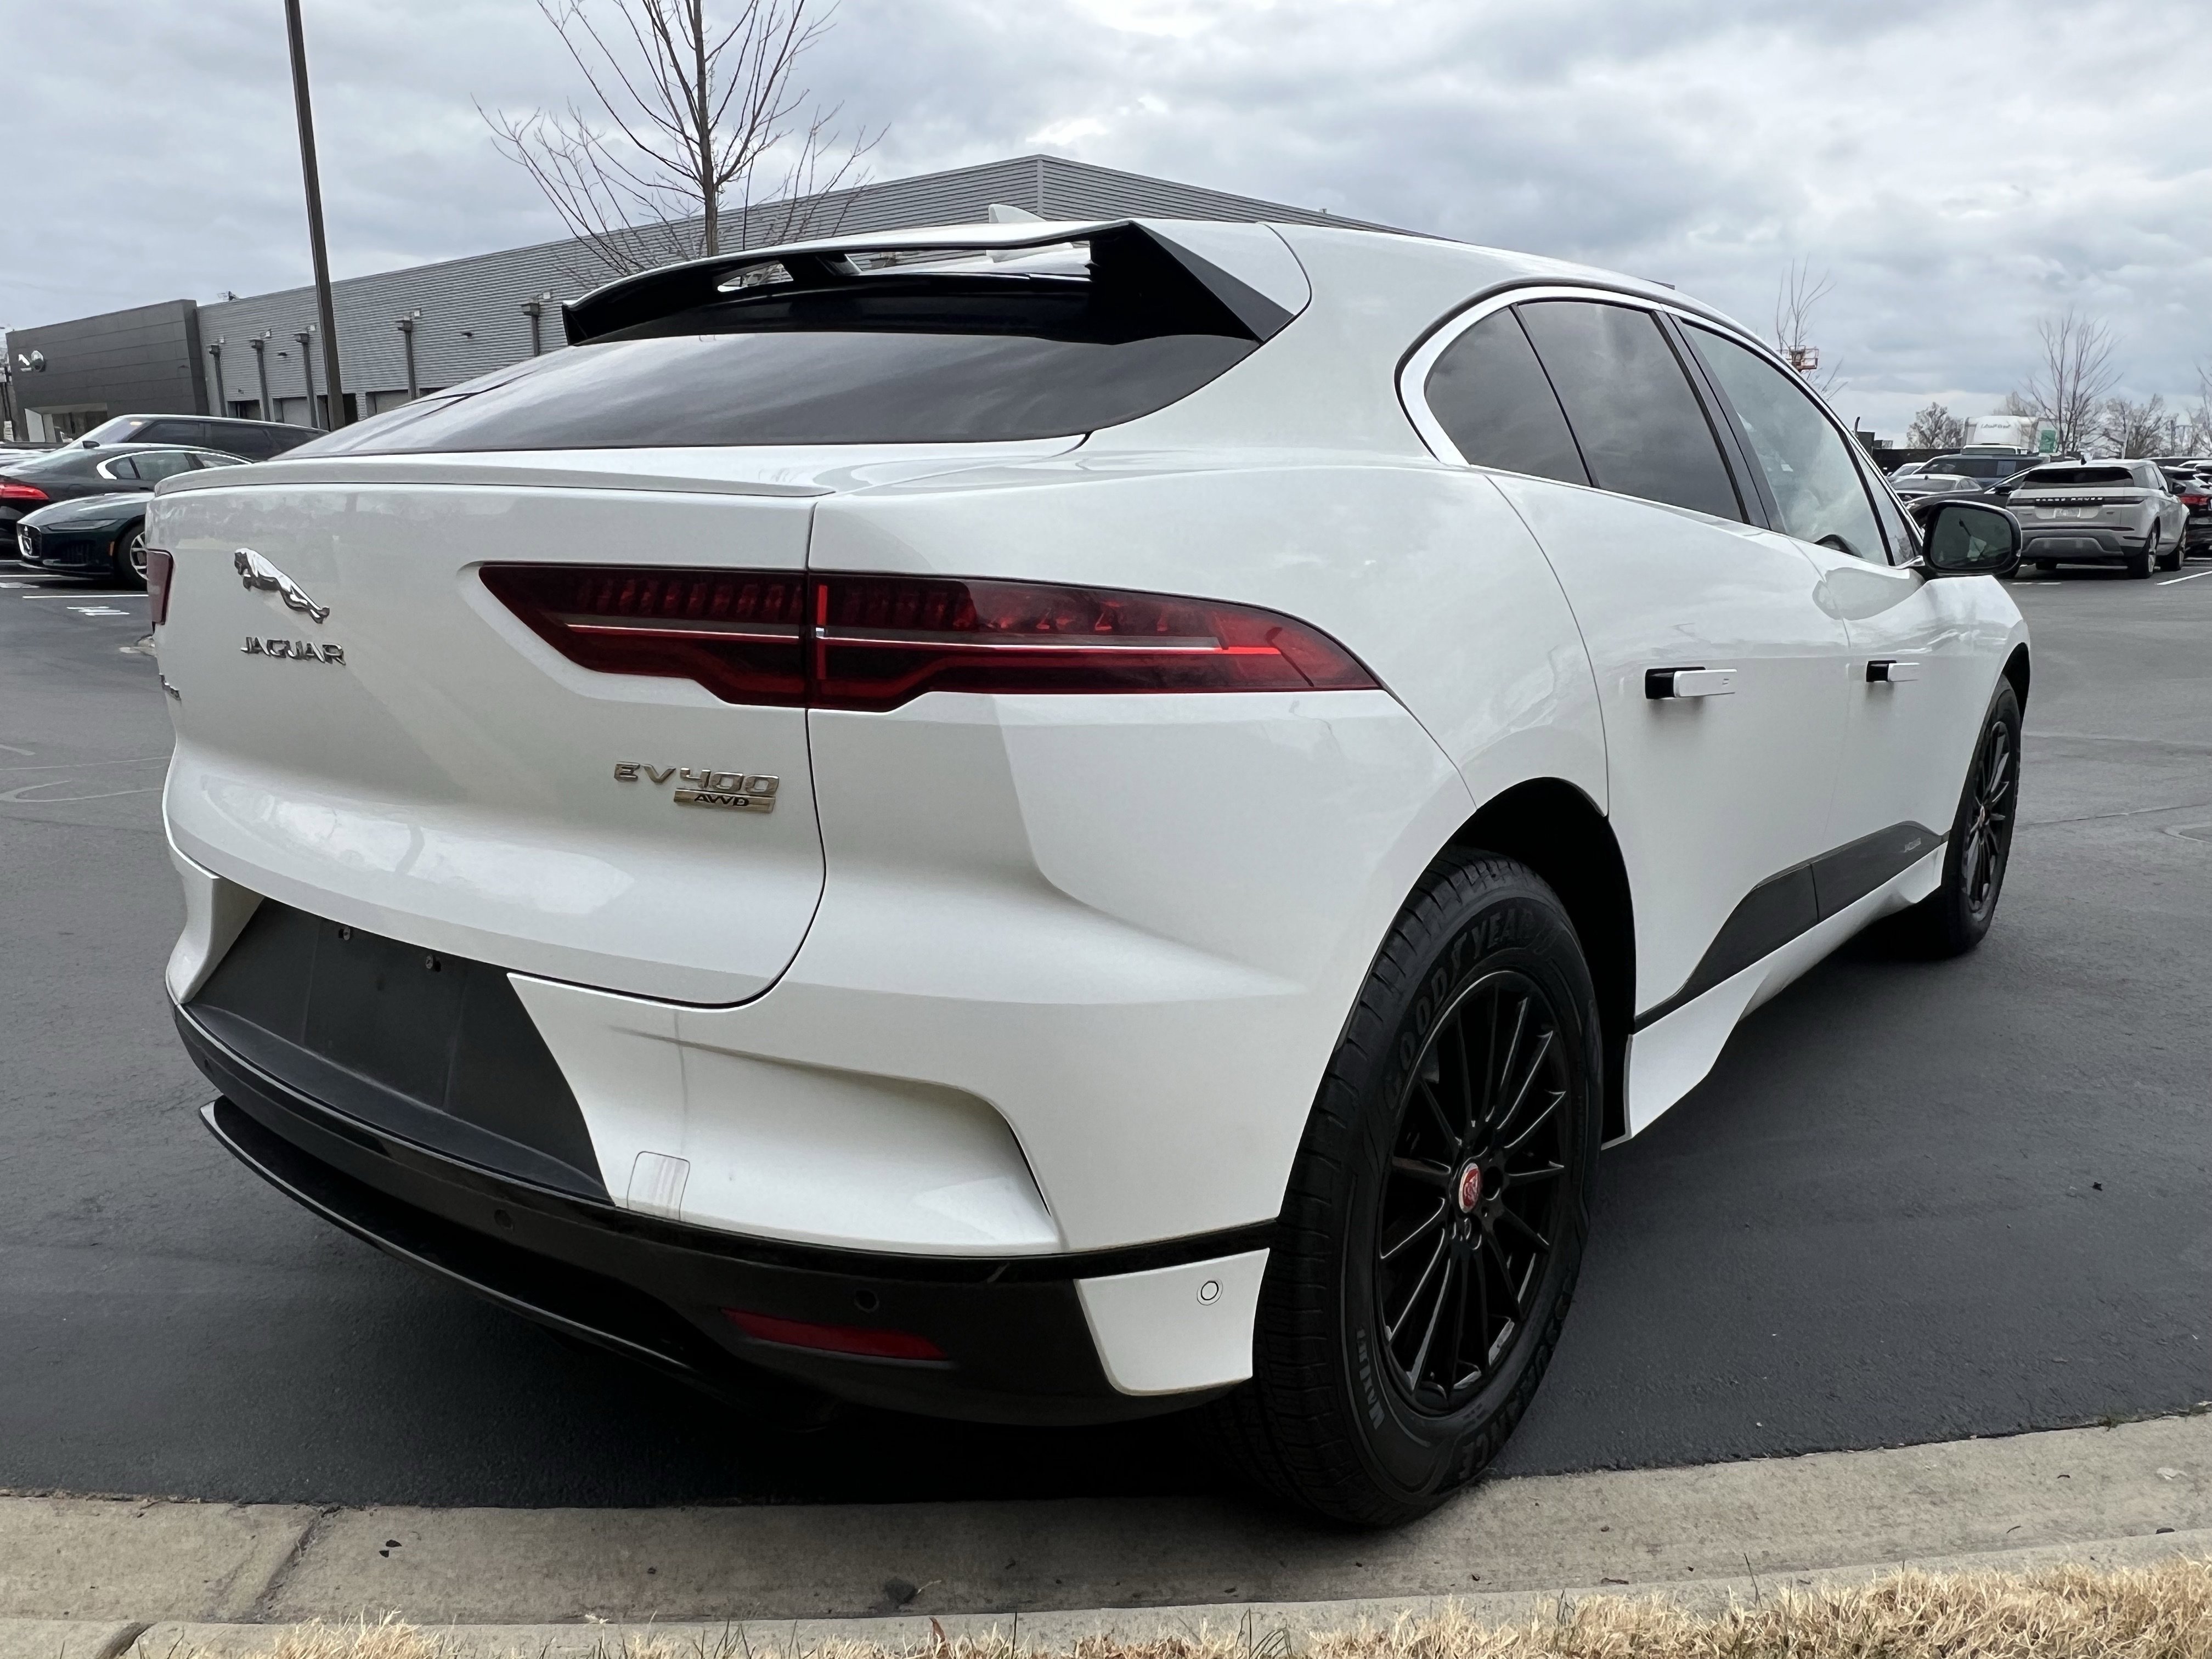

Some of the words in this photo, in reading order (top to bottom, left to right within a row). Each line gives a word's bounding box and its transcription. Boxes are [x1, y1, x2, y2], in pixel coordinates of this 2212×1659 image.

[240, 636, 346, 665] JAGUAR
[614, 761, 780, 794] EV400
[693, 793, 749, 807] AWD
